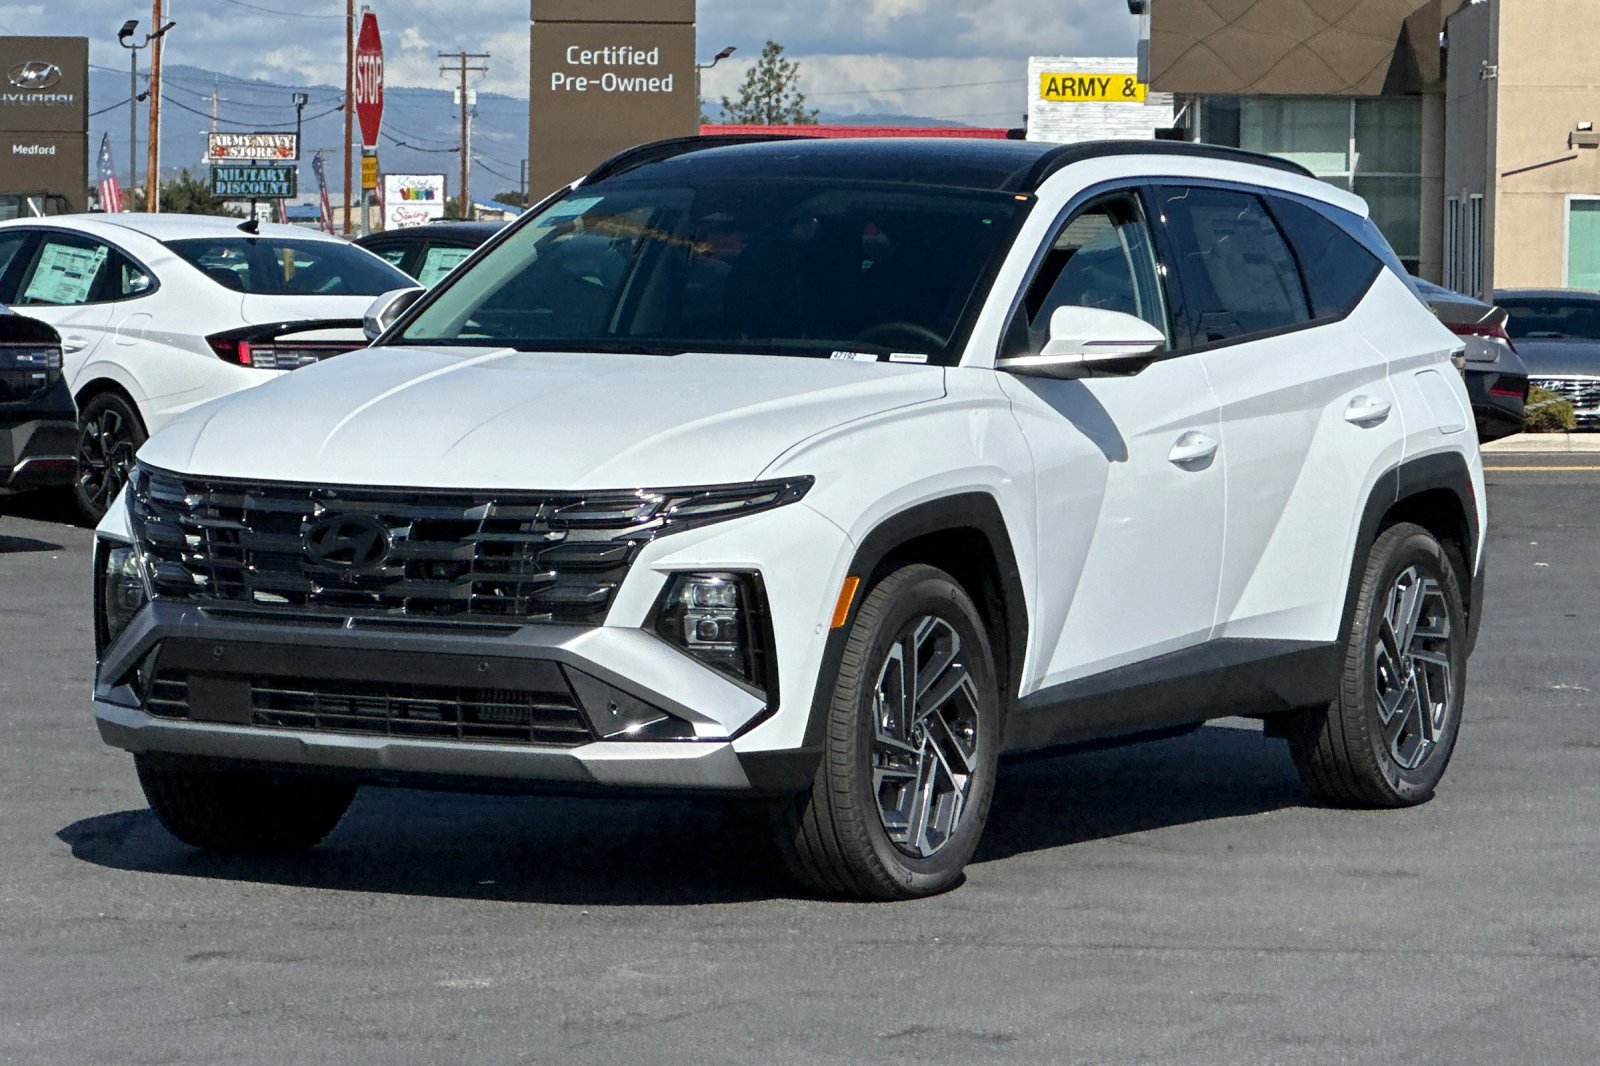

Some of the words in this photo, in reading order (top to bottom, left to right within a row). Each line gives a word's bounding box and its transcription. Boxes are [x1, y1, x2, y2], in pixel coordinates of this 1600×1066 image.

[566, 45, 659, 65] Certified
[356, 55, 382, 104] STOP
[551, 72, 673, 92] Pre-Owned
[1045, 77, 1111, 97] ARMY
[1121, 77, 1137, 97] &
[215, 135, 252, 146] ARMY
[256, 135, 291, 147] NAVY
[12, 144, 56, 155] Medford
[230, 147, 274, 157] STORE
[217, 168, 287, 181] MILITARY
[216, 181, 290, 194] DISCOUNT
